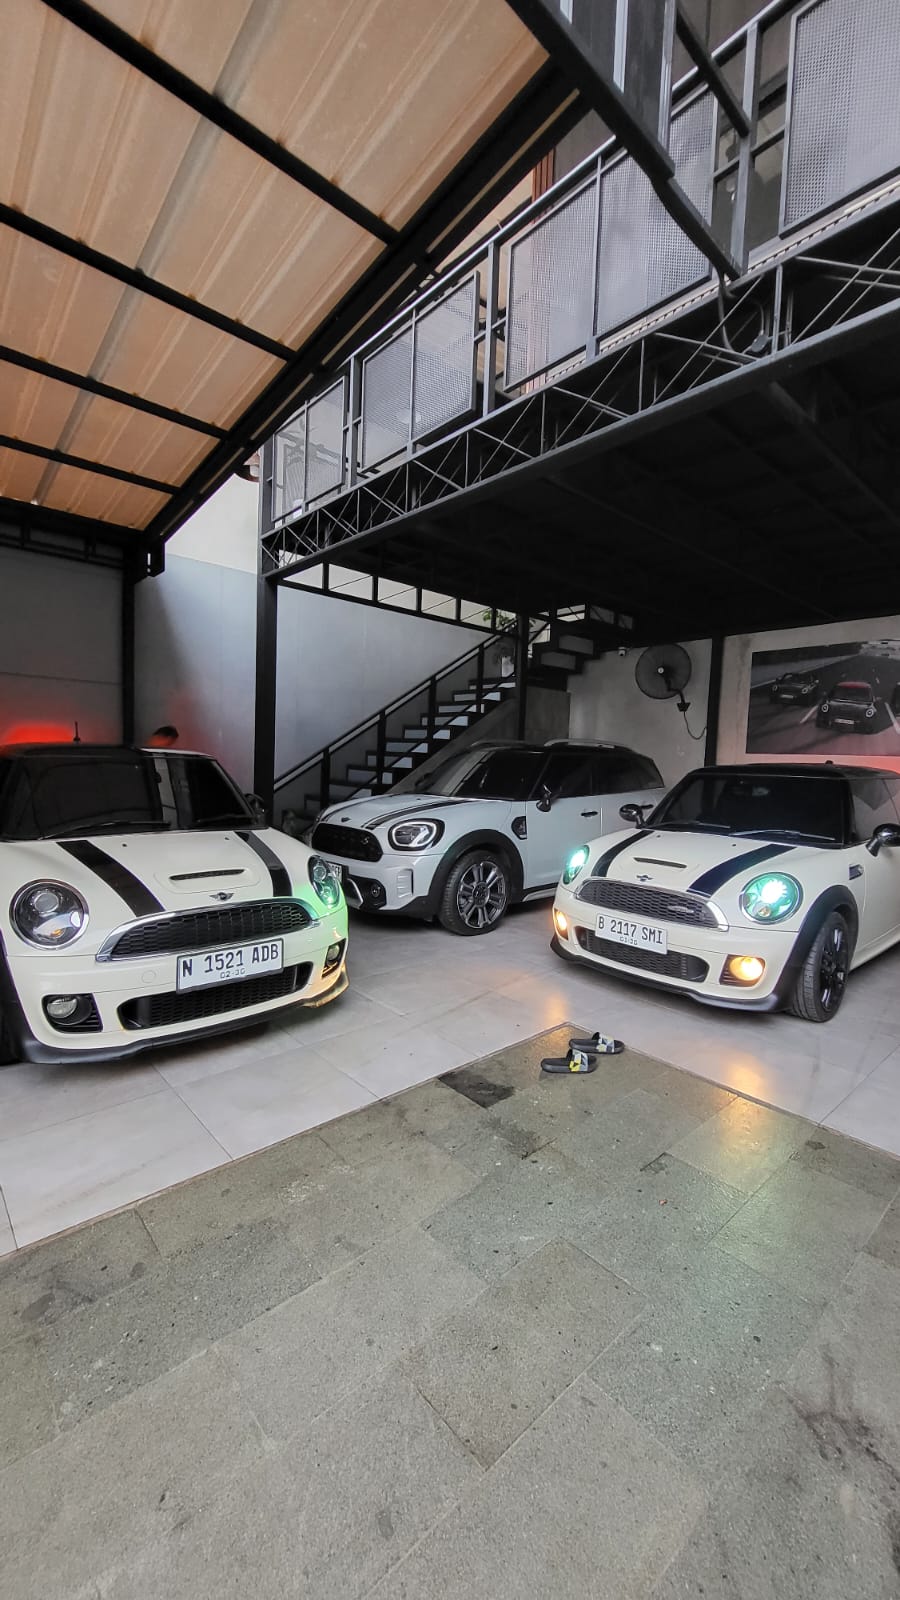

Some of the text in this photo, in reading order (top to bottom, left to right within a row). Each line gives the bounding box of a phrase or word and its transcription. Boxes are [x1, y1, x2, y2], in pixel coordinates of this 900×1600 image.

[598, 916, 663, 944] B 2117 SMI
[182, 943, 279, 977] N 1521 ADB
